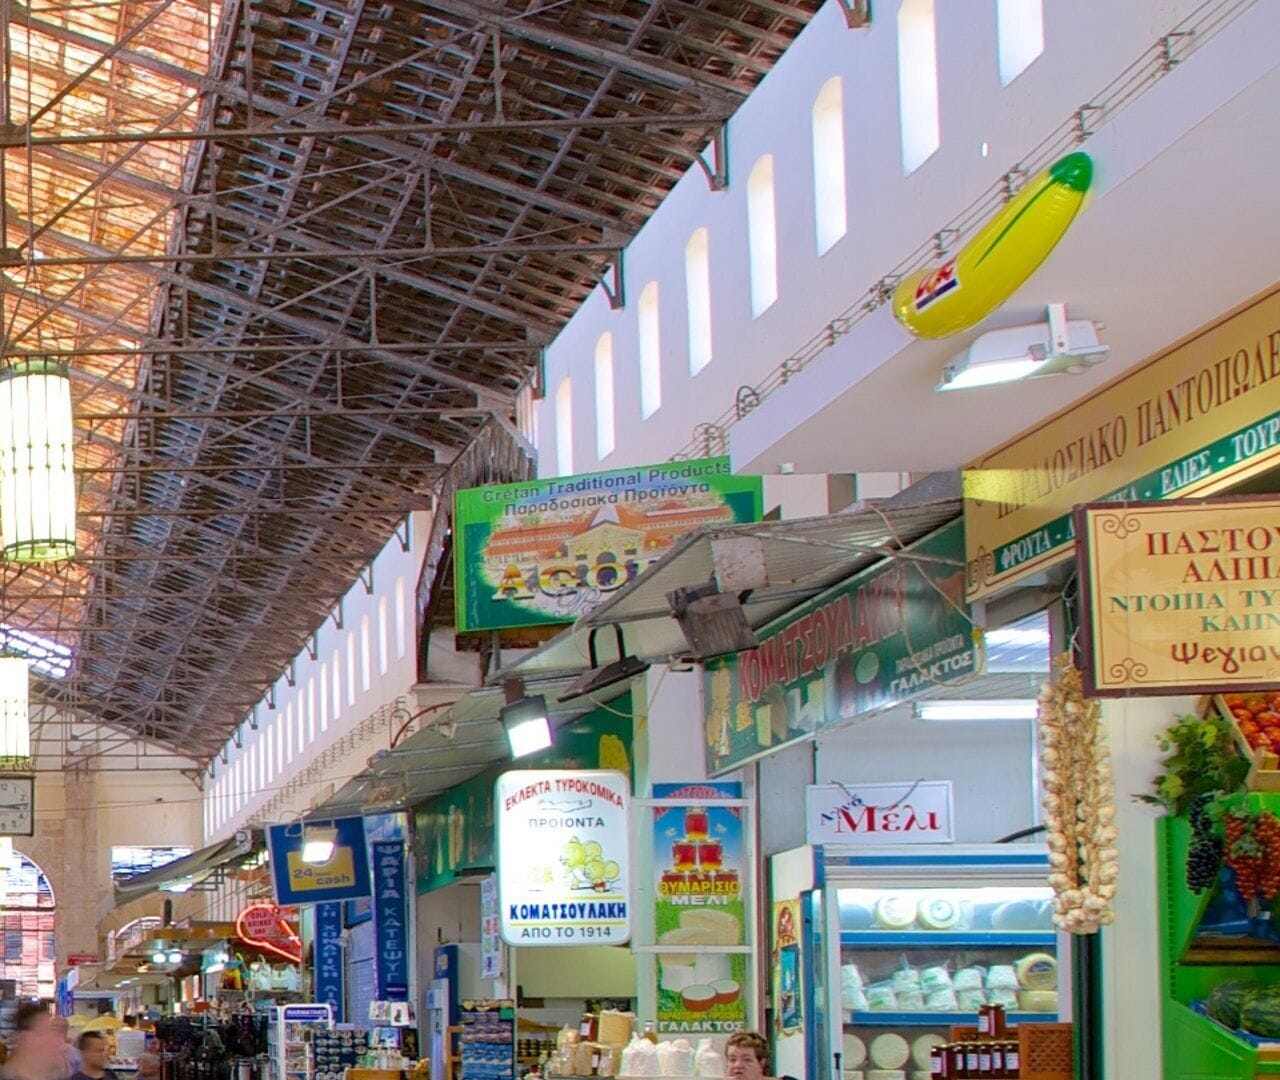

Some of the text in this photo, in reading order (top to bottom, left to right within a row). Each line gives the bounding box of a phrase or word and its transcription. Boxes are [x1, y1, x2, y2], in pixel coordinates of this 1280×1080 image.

[546, 470, 641, 494] Traditional
[648, 463, 731, 483] Products
[1001, 530, 1050, 569] ΦΡΟΥΤΑ
[1161, 450, 1211, 495] ΕΛΙΕΣ
[1182, 556, 1280, 583] ΑΛΙΠ
[1110, 590, 1280, 613] ΝΤΟΠΙΑ ΤΥ
[890, 651, 974, 692] ΓΑΛΑΚΤΟΣ
[505, 779, 624, 811] ΕΚΛΕΚΤΑ ΤΥΡΟΚΟΜΙΚΑ
[835, 804, 941, 833] Μέλι
[293, 869, 313, 878] 24
[316, 874, 350, 885] cash
[658, 881, 740, 894] ΘΥΜΑΡΙΣΙΟ
[671, 895, 729, 905] ΜΕΛΙ
[510, 902, 627, 920] ΚΟΜΑΤΣΟΥΛΑΚΗ
[521, 926, 611, 938] ΑΠΟ ΤΟ 1914
[659, 1021, 745, 1031] ΓΑΛΑΚΤΟΣ
